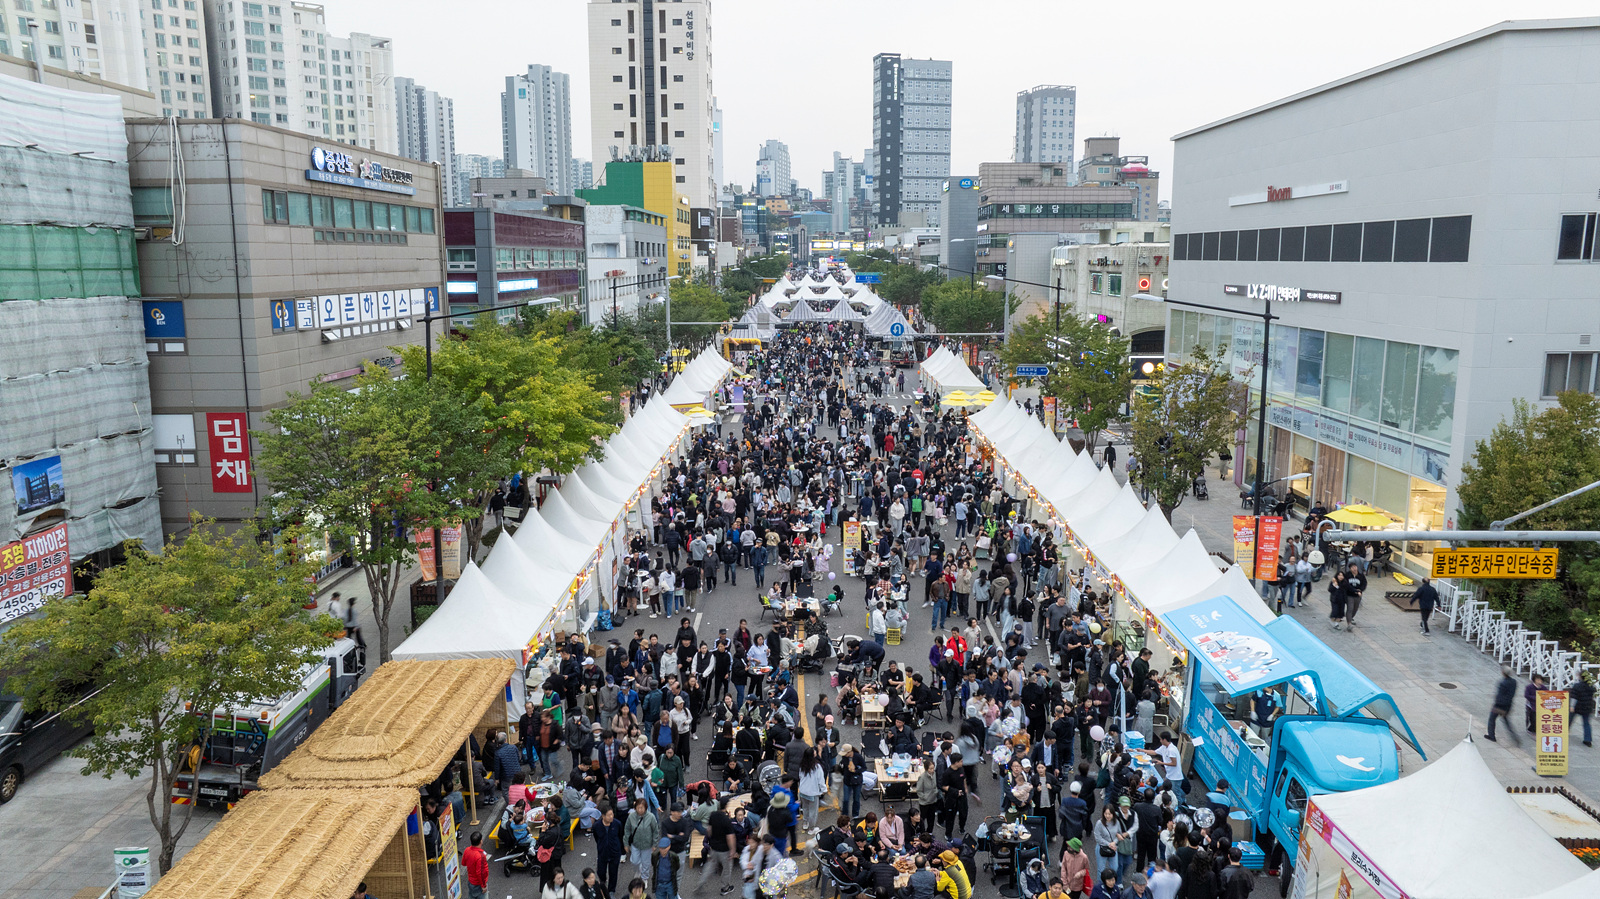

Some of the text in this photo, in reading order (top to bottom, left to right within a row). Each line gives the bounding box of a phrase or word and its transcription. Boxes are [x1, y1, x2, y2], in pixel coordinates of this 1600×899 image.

[324, 149, 356, 174] 증산도
[1267, 186, 1291, 202] iloom
[1247, 284, 1259, 299] LX
[1277, 286, 1300, 302] 인테리어
[213, 419, 248, 485] 딤채
[25, 527, 67, 559] 지하이전
[1436, 554, 1553, 575] 불법주정차무인단속중
[1541, 714, 1562, 724] 우측
[1541, 724, 1562, 734] 통행
